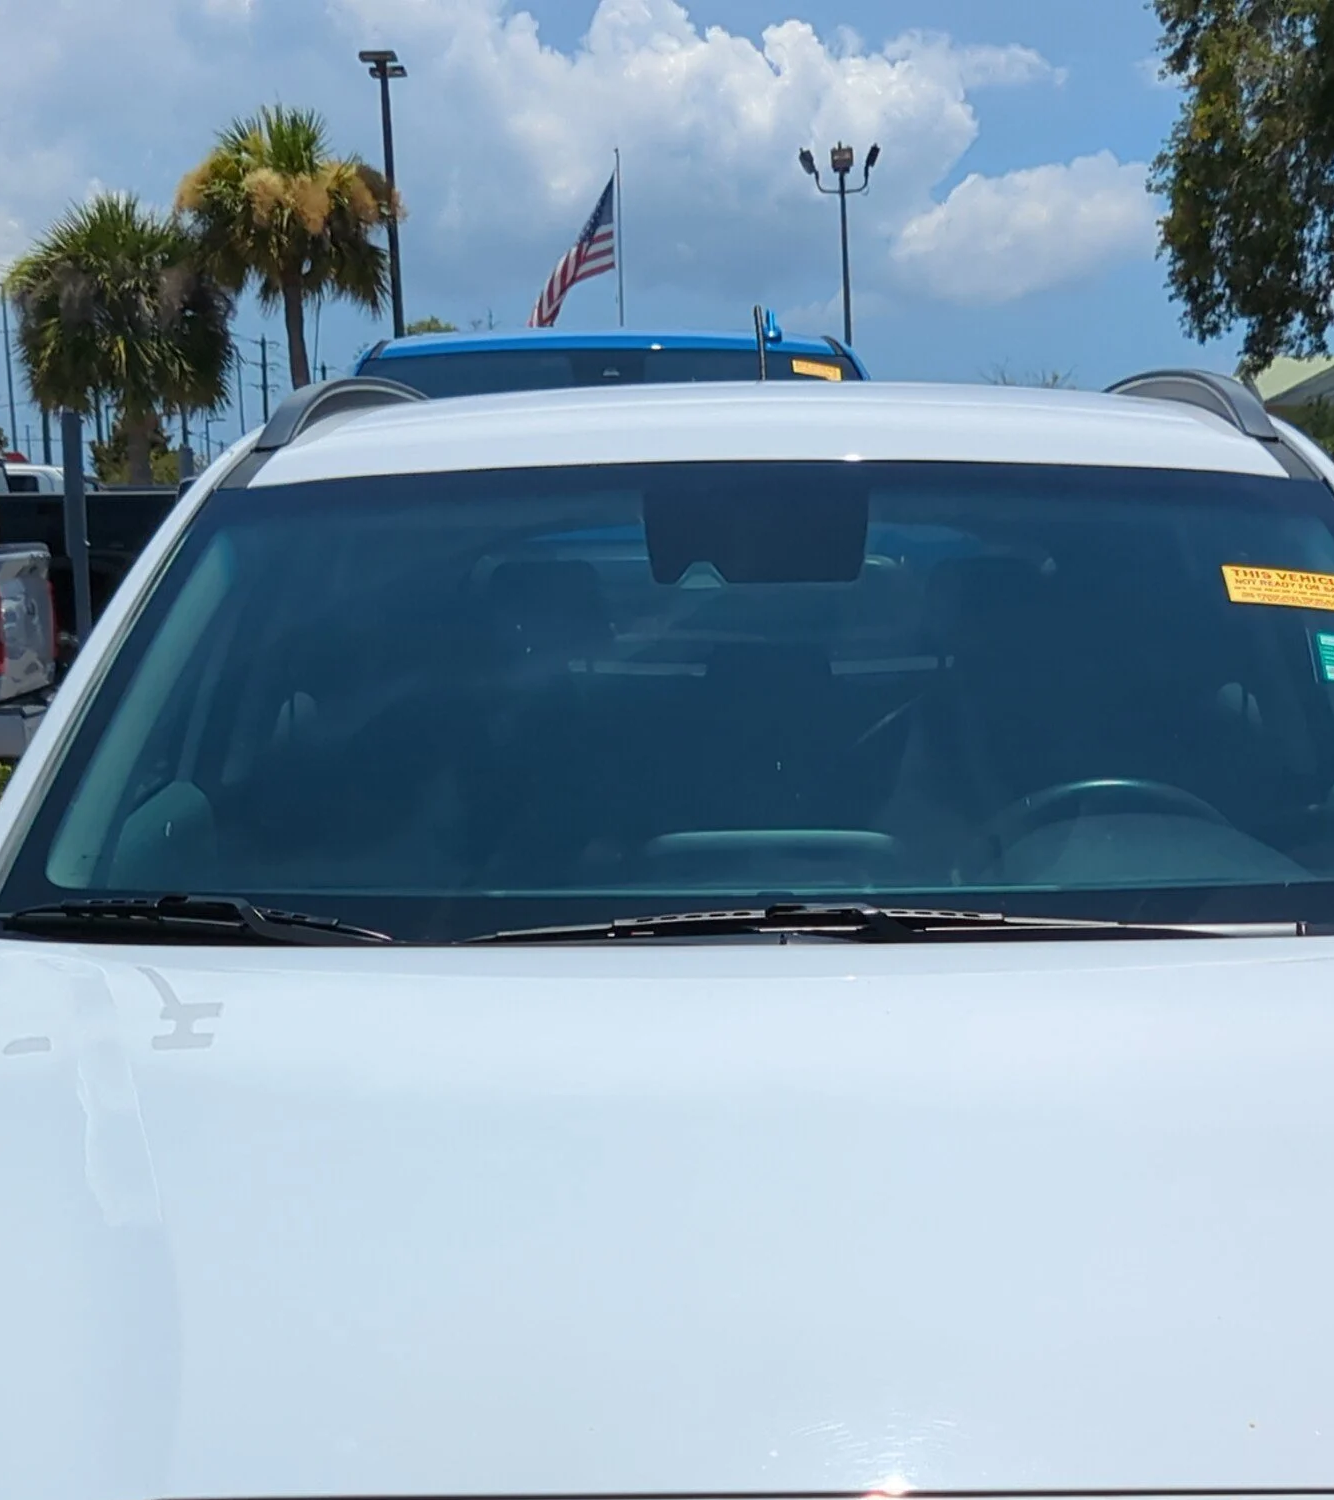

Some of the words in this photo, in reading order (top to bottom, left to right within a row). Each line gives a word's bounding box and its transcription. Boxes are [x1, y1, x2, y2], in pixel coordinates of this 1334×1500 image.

[1232, 568, 1271, 579] THIS
[1235, 578, 1257, 586] NOT
[1260, 579, 1296, 588] READY
